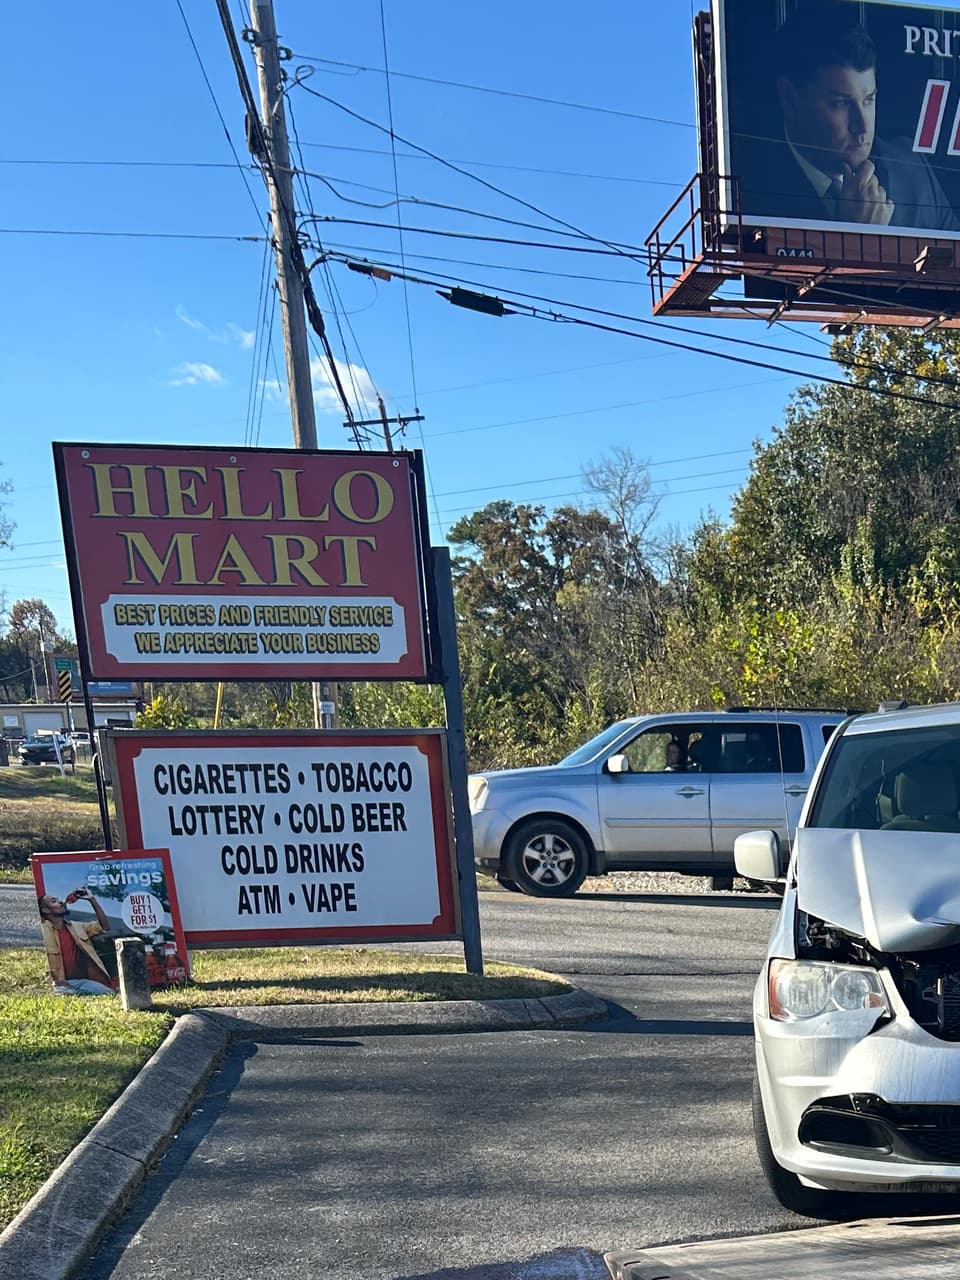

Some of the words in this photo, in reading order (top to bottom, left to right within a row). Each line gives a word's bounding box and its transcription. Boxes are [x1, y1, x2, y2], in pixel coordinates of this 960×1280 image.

[83, 463, 395, 524] HELLO
[117, 531, 377, 587] MART
[114, 604, 155, 625] BEST
[158, 604, 216, 626] PRICES
[219, 605, 251, 626] AND
[253, 605, 327, 627] FRIENDLY
[329, 606, 393, 627] SERVICE
[135, 632, 161, 653] WE
[163, 632, 259, 653] APPRECIATE
[260, 633, 304, 653] YOUR
[304, 633, 381, 653] BUSINESS
[153, 763, 291, 796] CIGARETTES
[311, 761, 413, 793] TOBACCO
[168, 804, 265, 836] LOTTERY
[288, 803, 345, 834] COLD
[351, 802, 407, 832] BEER
[221, 844, 278, 876] COLD
[284, 842, 365, 873] DRINKS
[87, 869, 163, 887] savings
[130, 895, 145, 905] BUY
[132, 905, 146, 914] GET
[237, 884, 283, 915] ATM
[301, 883, 358, 913] VAPE
[131, 915, 147, 925] FOR
